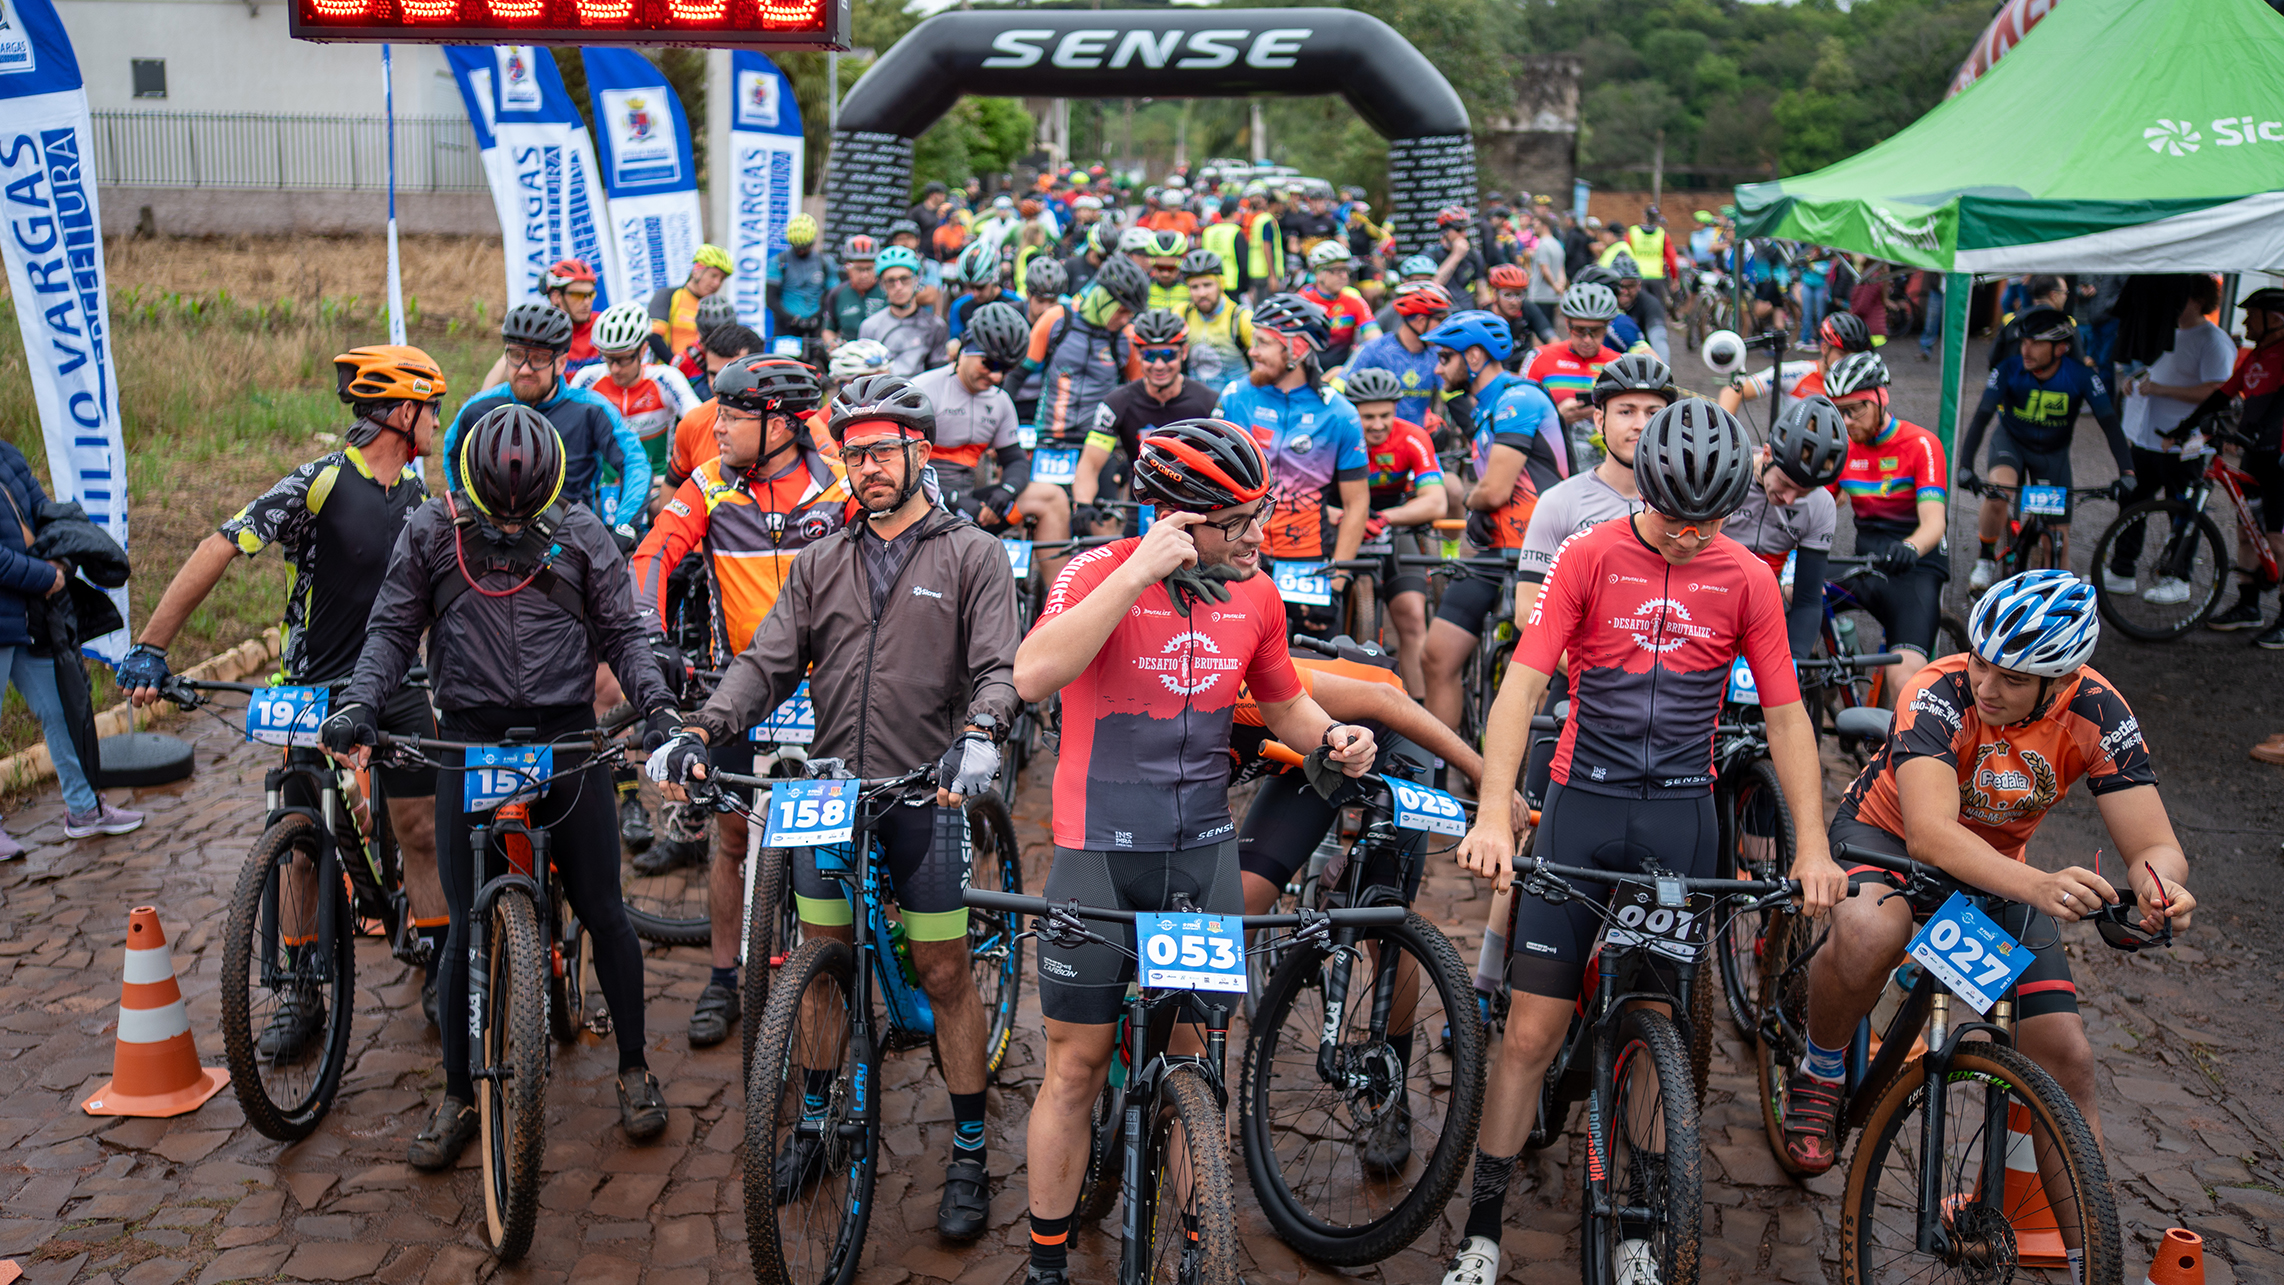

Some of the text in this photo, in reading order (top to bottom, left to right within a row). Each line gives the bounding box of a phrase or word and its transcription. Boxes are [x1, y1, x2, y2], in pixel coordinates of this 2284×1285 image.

[0, 41, 26, 53] ARGAS
[980, 28, 1314, 69] SENSE
[2211, 116, 2284, 147] Sic
[738, 147, 767, 249] VARGAS
[1, 134, 87, 376] VARGAS
[1039, 458, 1069, 474] 119
[1157, 464, 1182, 482] GIRO
[1521, 549, 1552, 565] 3TRE
[1045, 546, 1113, 615] SHIMANO
[1279, 573, 1324, 594] 061
[1526, 527, 1591, 626] SHIMANO
[921, 588, 943, 599] Sicredi
[1143, 608, 1172, 617] BRUTALIZE
[1613, 617, 1711, 638] DESAFIO BRUTALIZE
[1137, 656, 1238, 672] DESAFIO BRUTALIZE
[256, 701, 318, 730] 194
[476, 767, 539, 794] 153
[1981, 771, 2028, 789] Pedala
[778, 799, 844, 829] 158
[1397, 787, 1458, 817] 025
[1114, 830, 1132, 839] INS
[1196, 822, 1234, 841] SENSE
[1616, 904, 1694, 940] 001
[1144, 933, 1234, 969] 053
[1929, 920, 2011, 987] 027
[1042, 963, 1077, 978] CARBON
[468, 993, 481, 1039] FOX
[1321, 1000, 1342, 1046] FOX
[989, 1027, 1011, 1072] MAXXIS
[853, 1063, 868, 1112] Lefty
[1245, 1035, 1262, 1116] KENDA
[1588, 1113, 1607, 1182] ROCKSHOX
[1844, 1214, 1853, 1285] AXXIS
